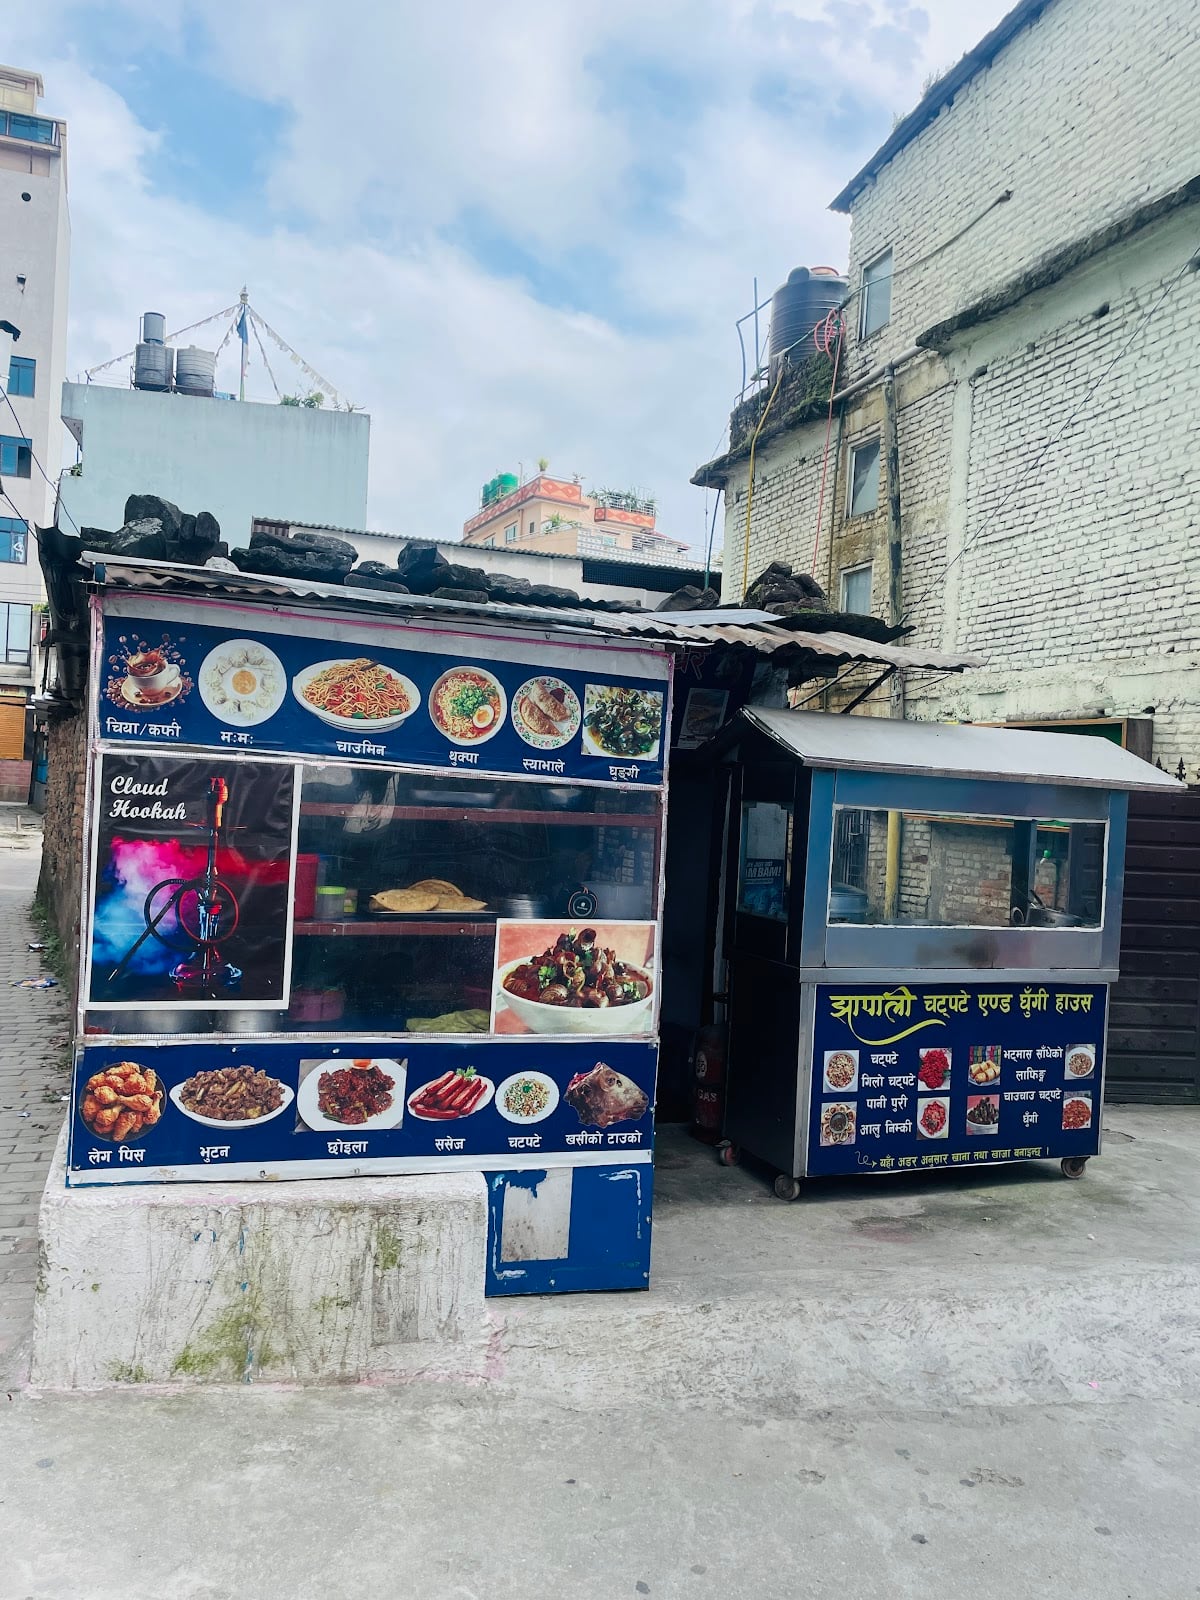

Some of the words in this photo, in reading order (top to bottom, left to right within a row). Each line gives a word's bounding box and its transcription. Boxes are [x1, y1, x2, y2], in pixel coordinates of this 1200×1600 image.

[336, 740, 386, 757] चाउमिन
[449, 750, 479, 767] थुक्पा
[522, 758, 565, 773] स्याभाले
[110, 776, 168, 796] Cloud
[109, 799, 186, 820] Hookah
[922, 990, 971, 1018] चट्पटे
[978, 993, 1013, 1017] एण्ड
[1055, 993, 1093, 1014] हाउस
[870, 1051, 899, 1067] चट्पटे
[888, 1073, 916, 1089] चट्पटे
[697, 1088, 718, 1103] GAS
[866, 1095, 887, 1110] पानी
[891, 1094, 908, 1112] पुरी
[1003, 1091, 1036, 1102] चाउचाउ
[565, 1130, 603, 1147] खसीको
[607, 1129, 643, 1145] टाउको
[860, 1123, 881, 1138] आलु
[327, 1139, 368, 1155] छोइला
[435, 1136, 466, 1151] ससेज
[507, 1133, 542, 1149] चटपटे
[88, 1147, 112, 1164] लेग
[118, 1145, 146, 1163] पिस
[200, 1145, 231, 1163] भुटन
[880, 1154, 895, 1169] यहाँ
